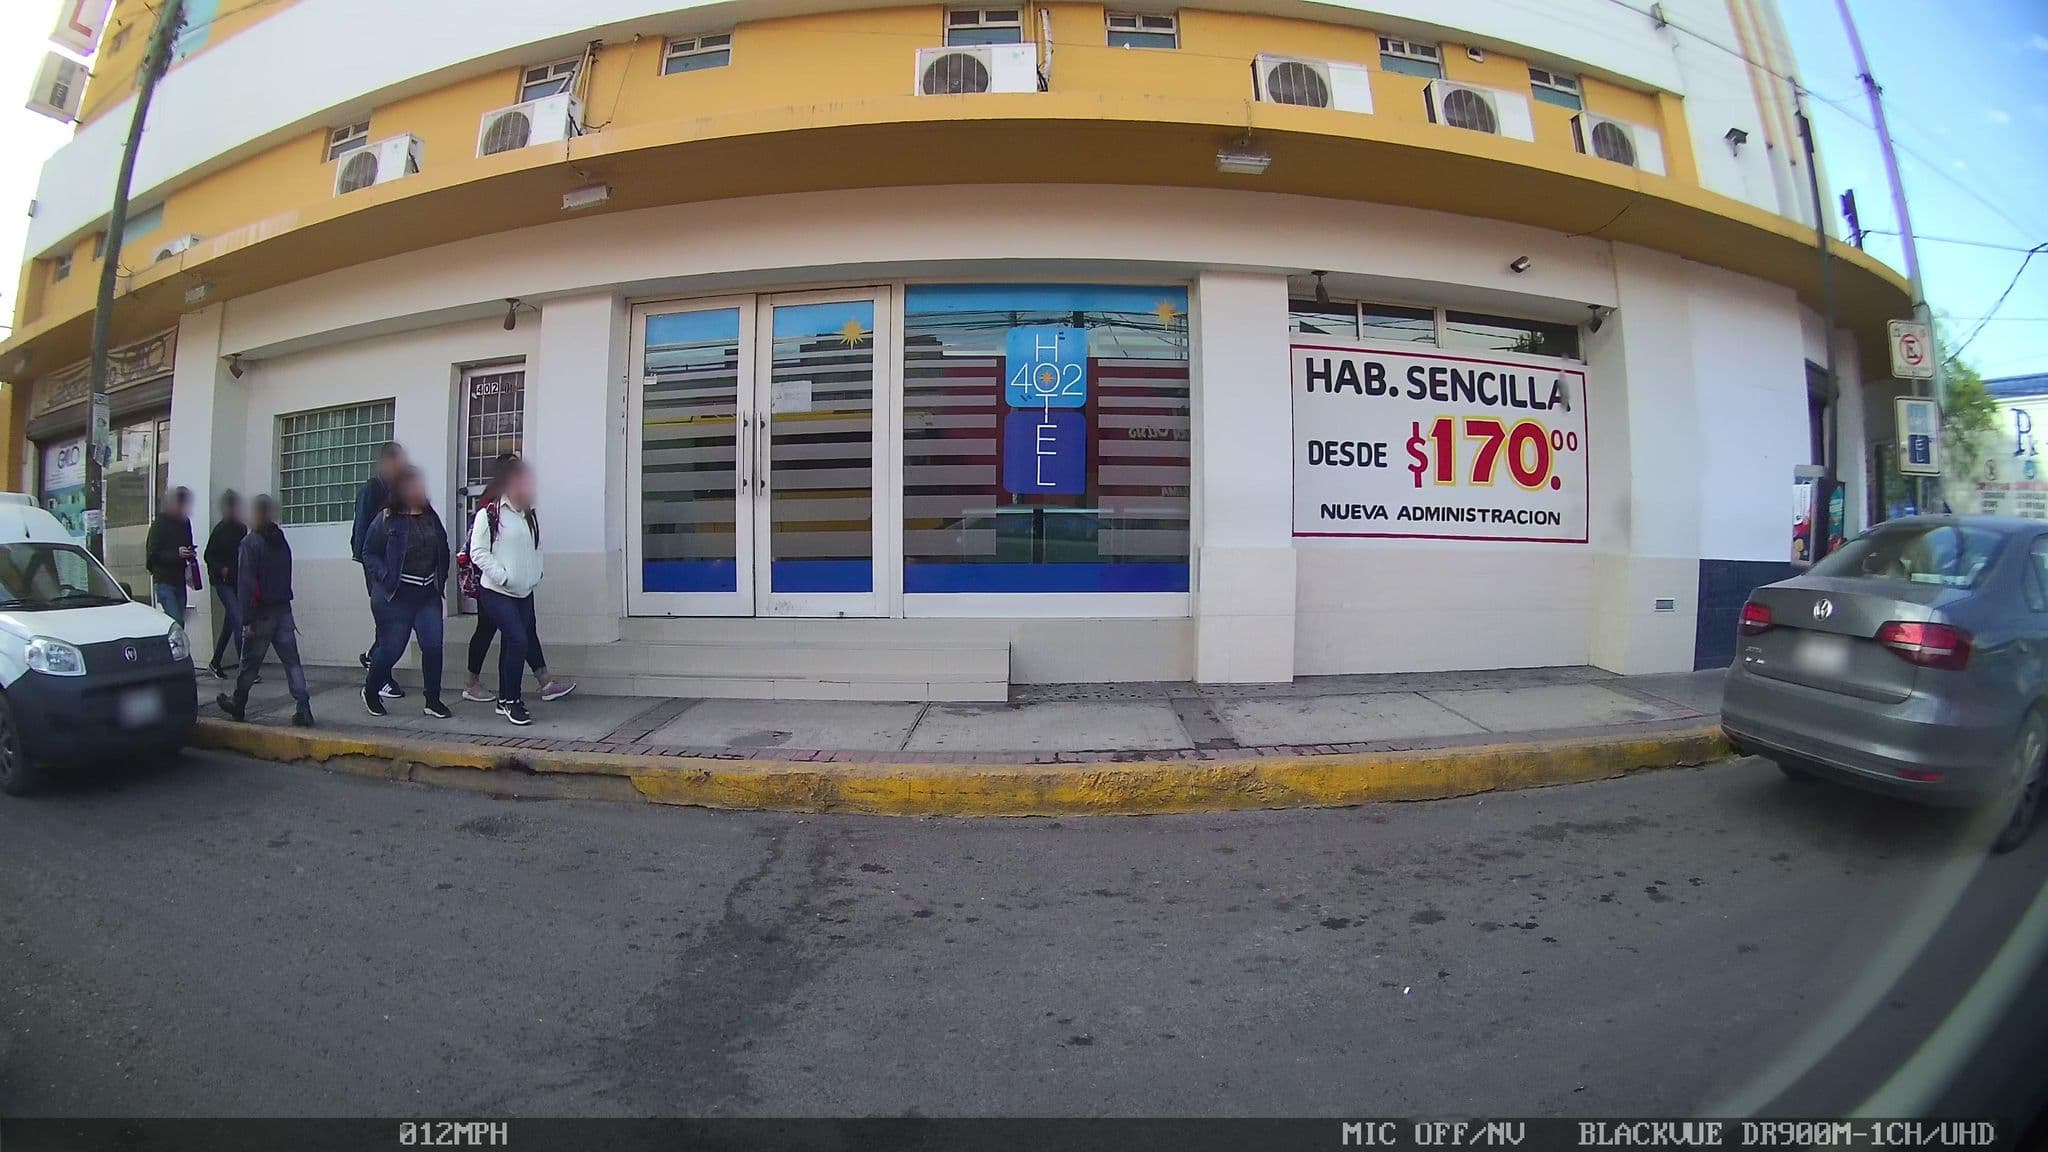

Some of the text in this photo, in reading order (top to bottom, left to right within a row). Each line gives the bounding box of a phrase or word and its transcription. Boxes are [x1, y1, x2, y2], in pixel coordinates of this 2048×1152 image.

[477, 383, 498, 394] 402
[1010, 362, 1083, 396] 402
[1305, 357, 1572, 413] HAB. SENCILLA
[1033, 333, 1061, 486] HOTEL
[1308, 440, 1388, 468] DESDE
[1320, 503, 1561, 525] NUEVA ADMINISTRACION
